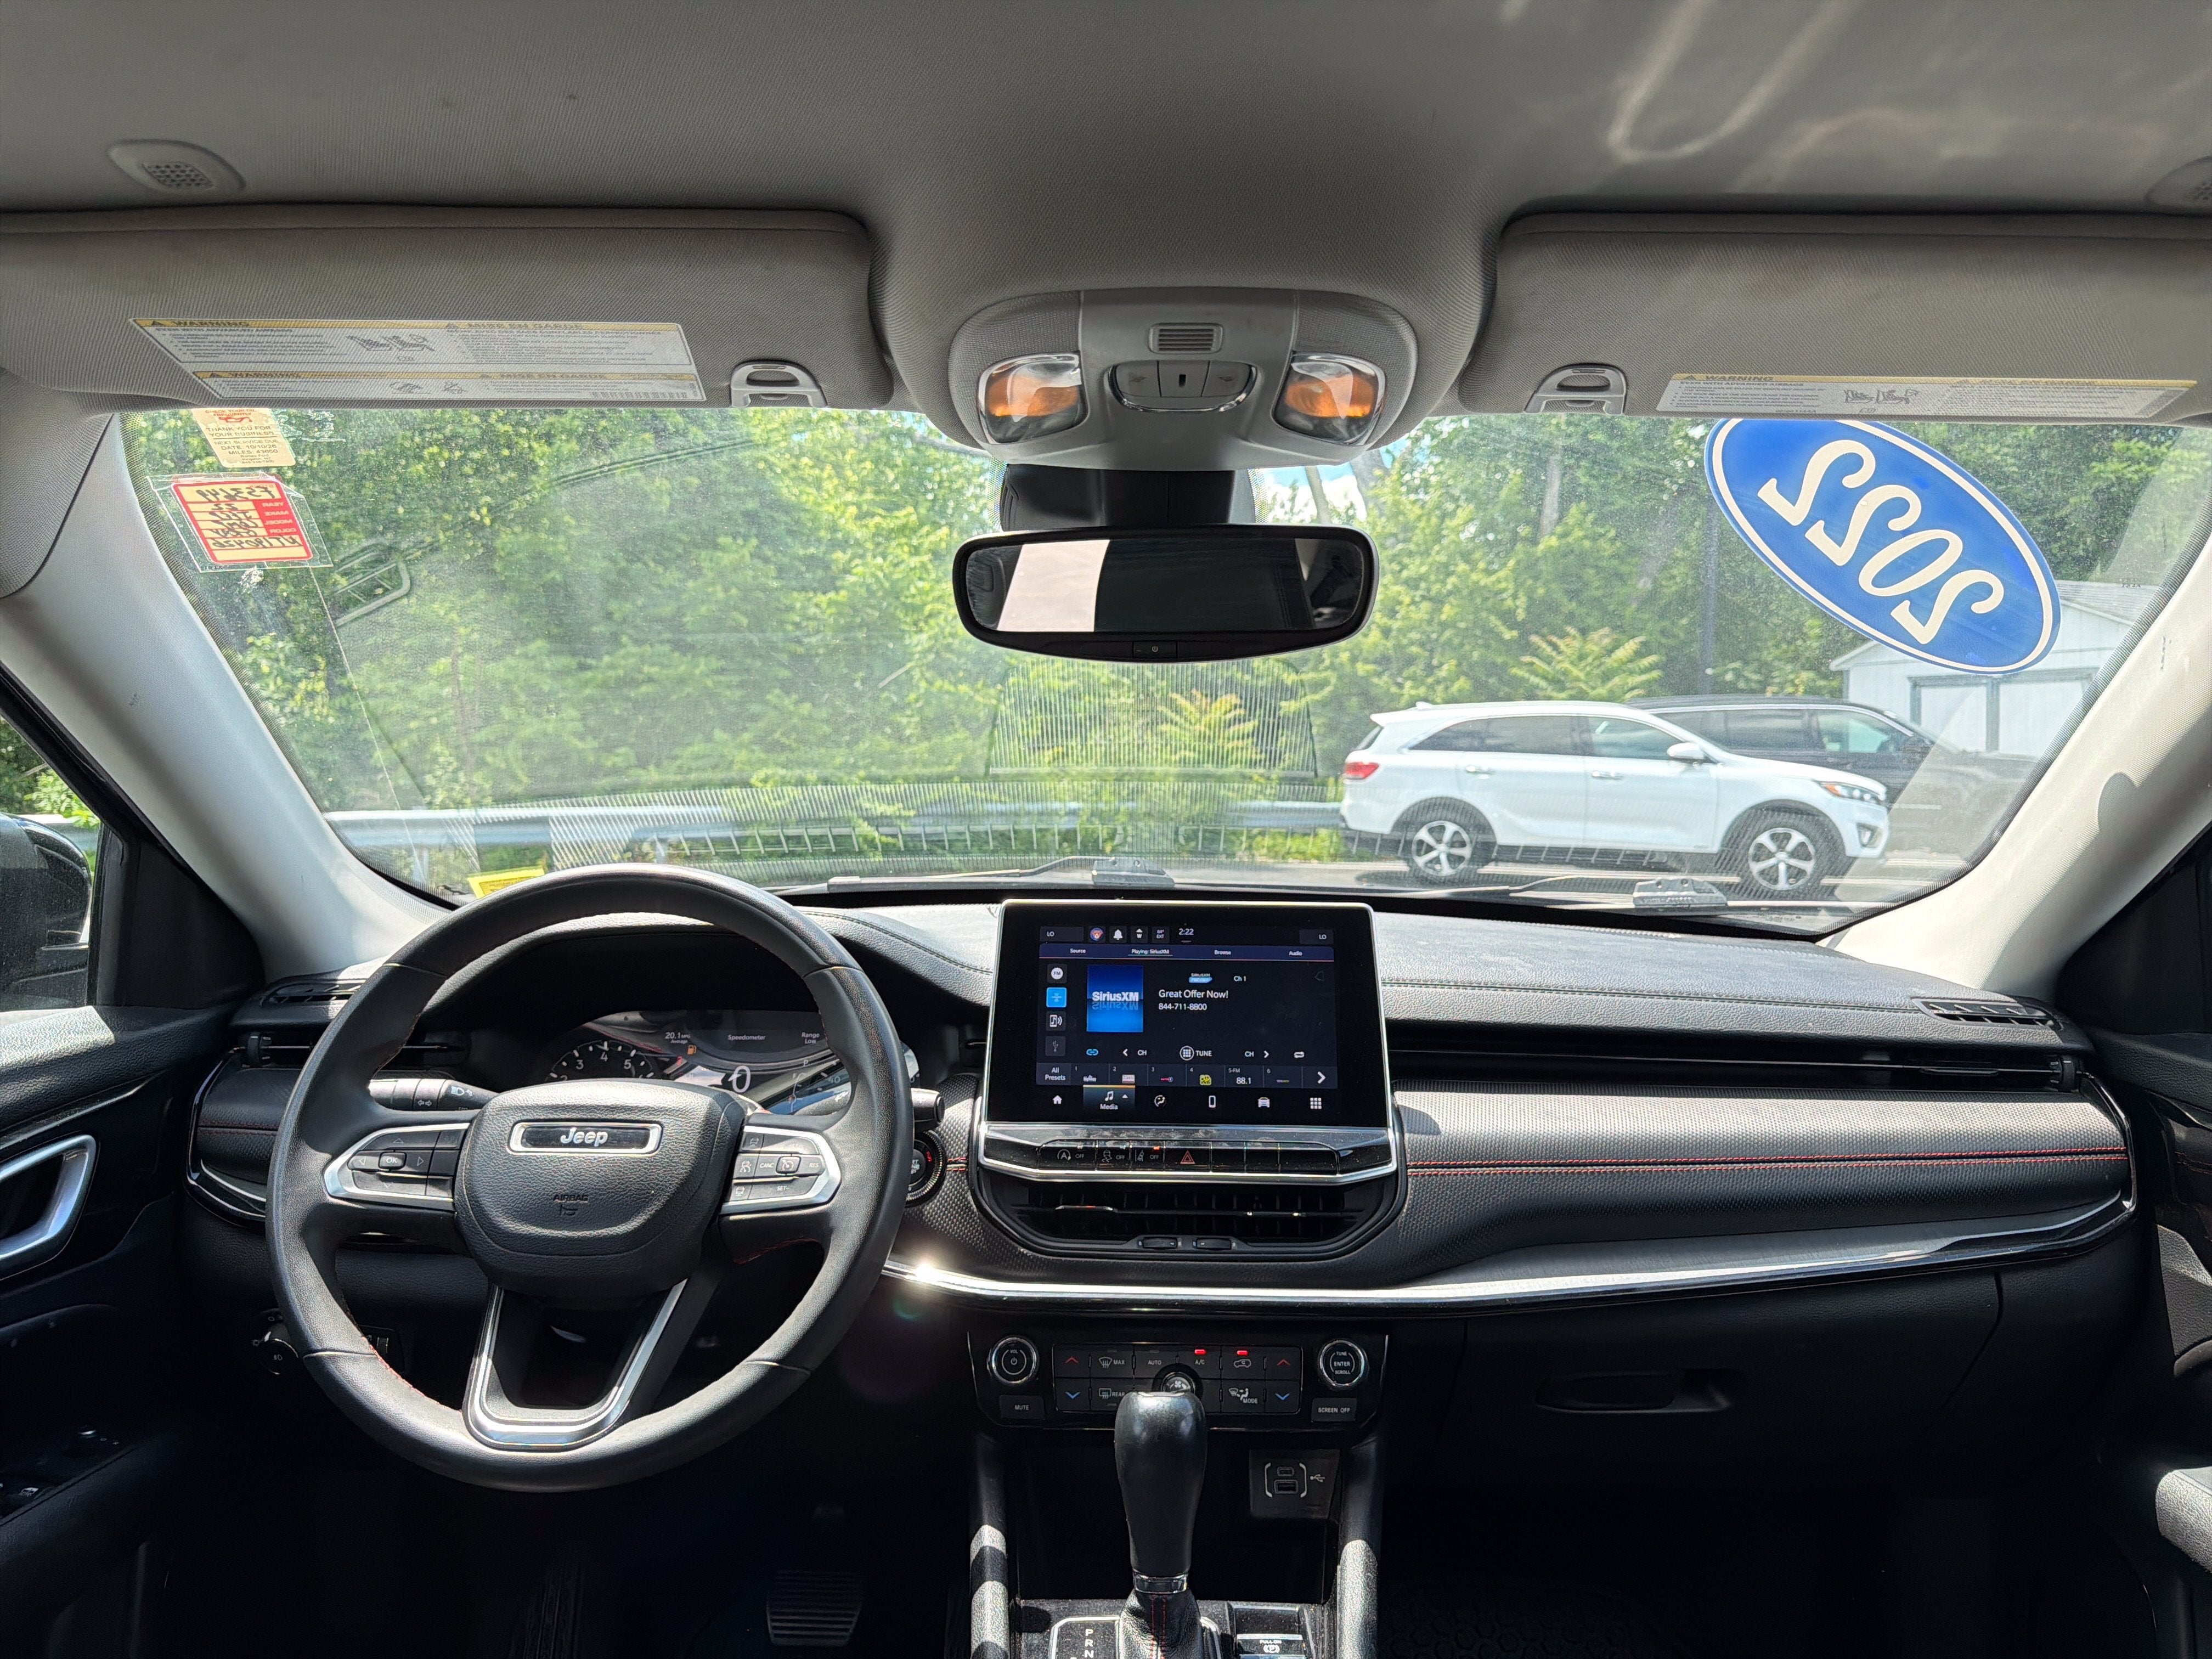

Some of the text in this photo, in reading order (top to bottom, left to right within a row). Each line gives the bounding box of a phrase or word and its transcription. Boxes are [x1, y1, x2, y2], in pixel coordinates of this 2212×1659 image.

[1092, 991, 1139, 1002] SiriusXM
[1159, 989, 1228, 998] Great Offer Now!
[600, 1051, 608, 1062] 4
[575, 1059, 584, 1070] 3
[623, 1059, 631, 1070] 5
[560, 1127, 608, 1147] Jeep
[1085, 1628, 1094, 1637] P
[1085, 1639, 1093, 1647] R
[1084, 1650, 1094, 1658] N
